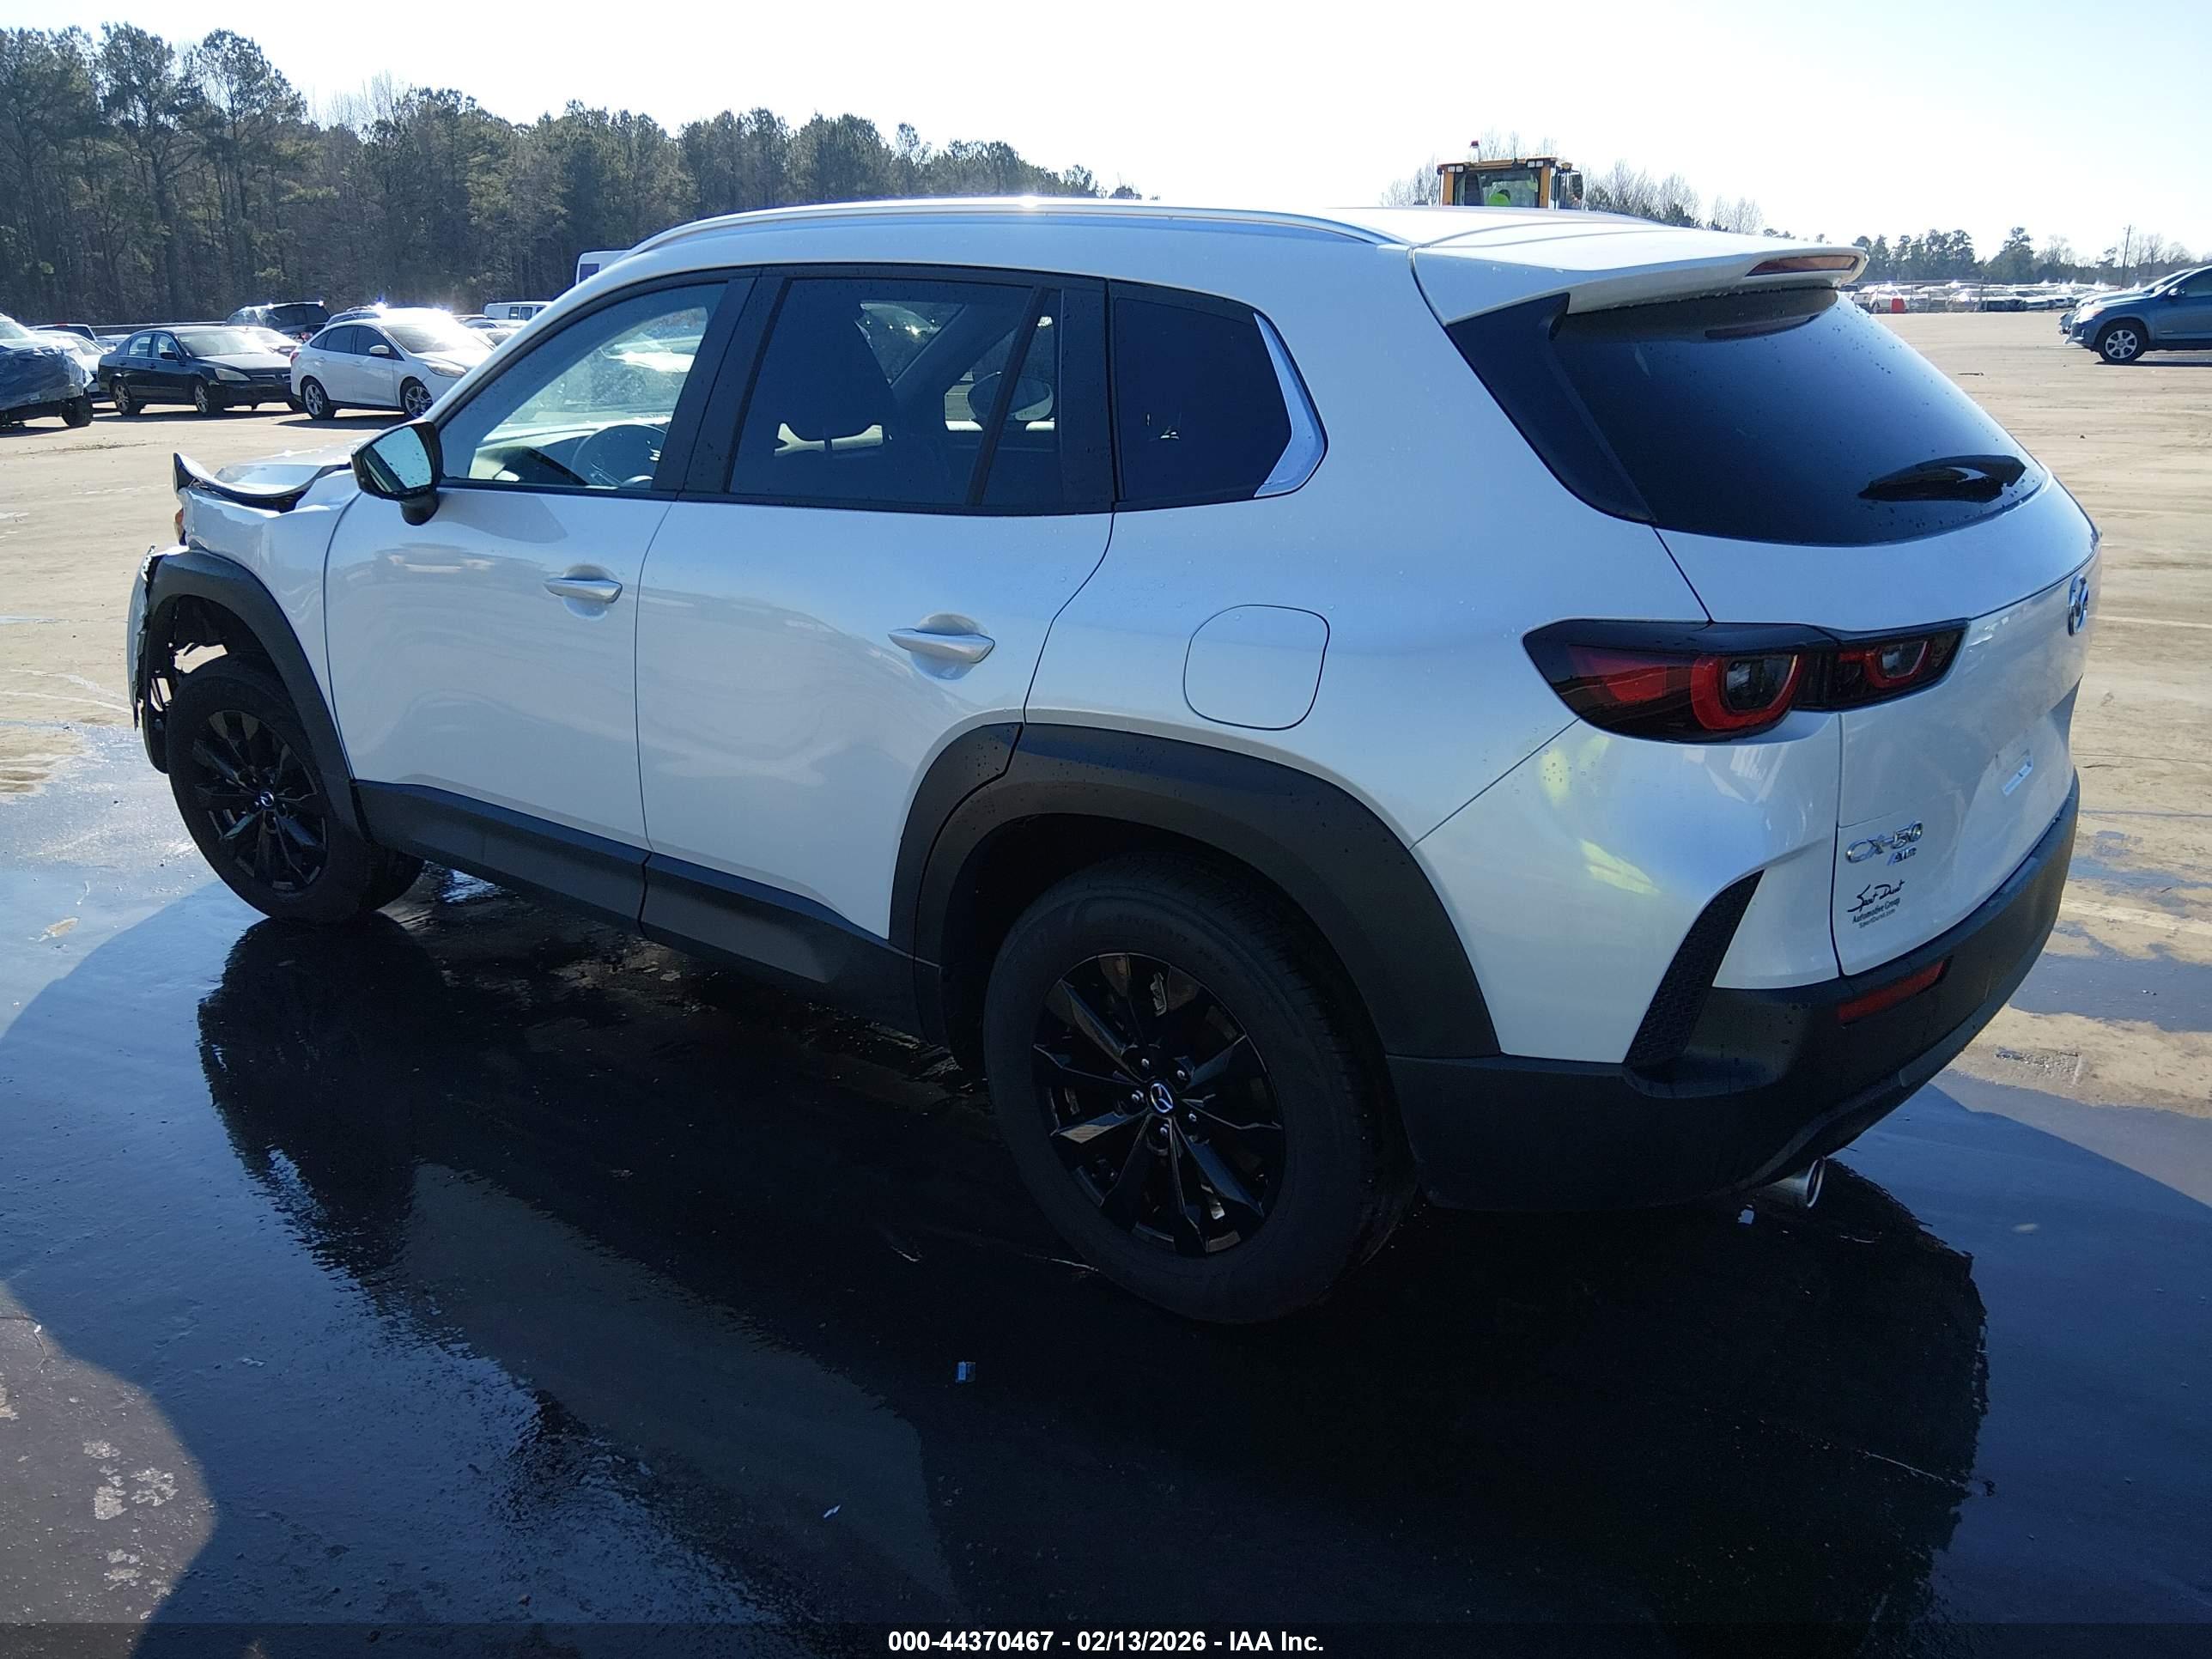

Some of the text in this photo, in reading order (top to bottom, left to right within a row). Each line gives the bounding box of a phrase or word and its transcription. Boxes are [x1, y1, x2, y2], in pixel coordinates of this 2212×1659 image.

[1845, 820, 1923, 864] CX-50
[1852, 897, 1900, 924] Automotive Group
